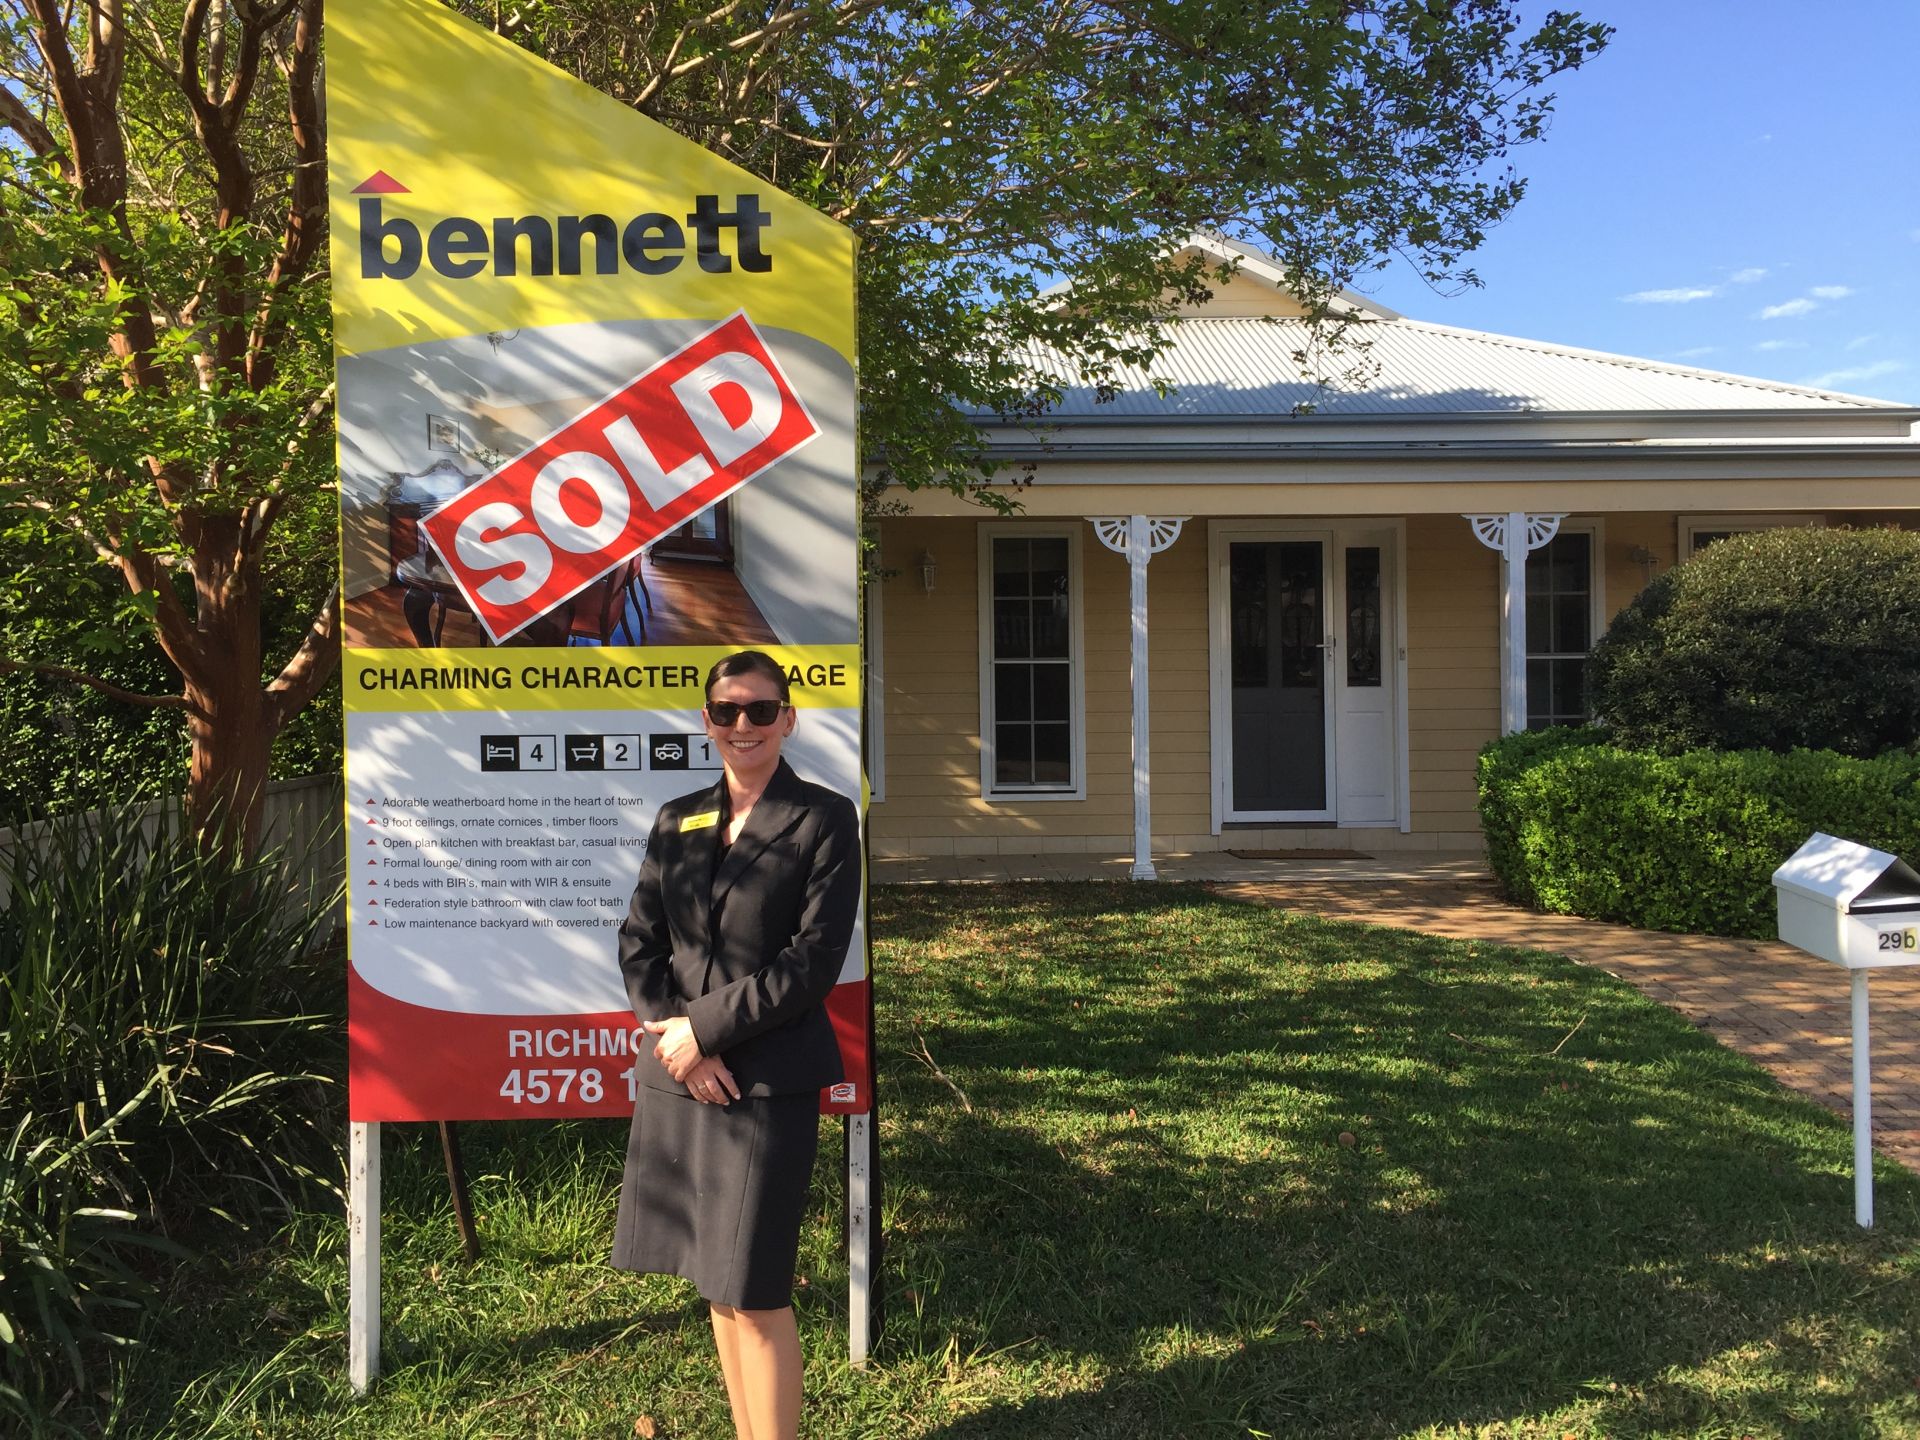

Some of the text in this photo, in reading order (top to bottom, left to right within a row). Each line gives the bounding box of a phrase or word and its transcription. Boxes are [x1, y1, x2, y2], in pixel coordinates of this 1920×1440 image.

[359, 193, 773, 280] bennett
[454, 350, 783, 606] SOLD
[359, 666, 512, 691] CHARMING
[520, 665, 700, 689] CHARACTER
[530, 744, 544, 762] 4
[615, 743, 629, 761] 2
[701, 742, 710, 761] 1
[382, 796, 643, 808] Adorable weatherboard home in the heart of town
[382, 818, 389, 828] 9
[392, 818, 413, 828] foot
[415, 817, 459, 830] ceilings,
[461, 818, 495, 827] ornate
[498, 817, 543, 827] cornices
[552, 817, 586, 827] timber
[589, 816, 619, 827] floors
[383, 836, 648, 850] Open plan kitchen with breakfast bar, casual living
[383, 857, 592, 870] Formal lounge/ dining room with air con
[383, 877, 612, 888] 4 beds with BIR's, main with WIR & ensuite
[384, 897, 624, 910] Federation style bathroom with claw foot bath
[385, 917, 625, 930] Low maintenance backyard with covered ente
[1879, 931, 1915, 949] 29b
[508, 1028, 646, 1057] RICHMO
[500, 1067, 637, 1104] 4578 1
